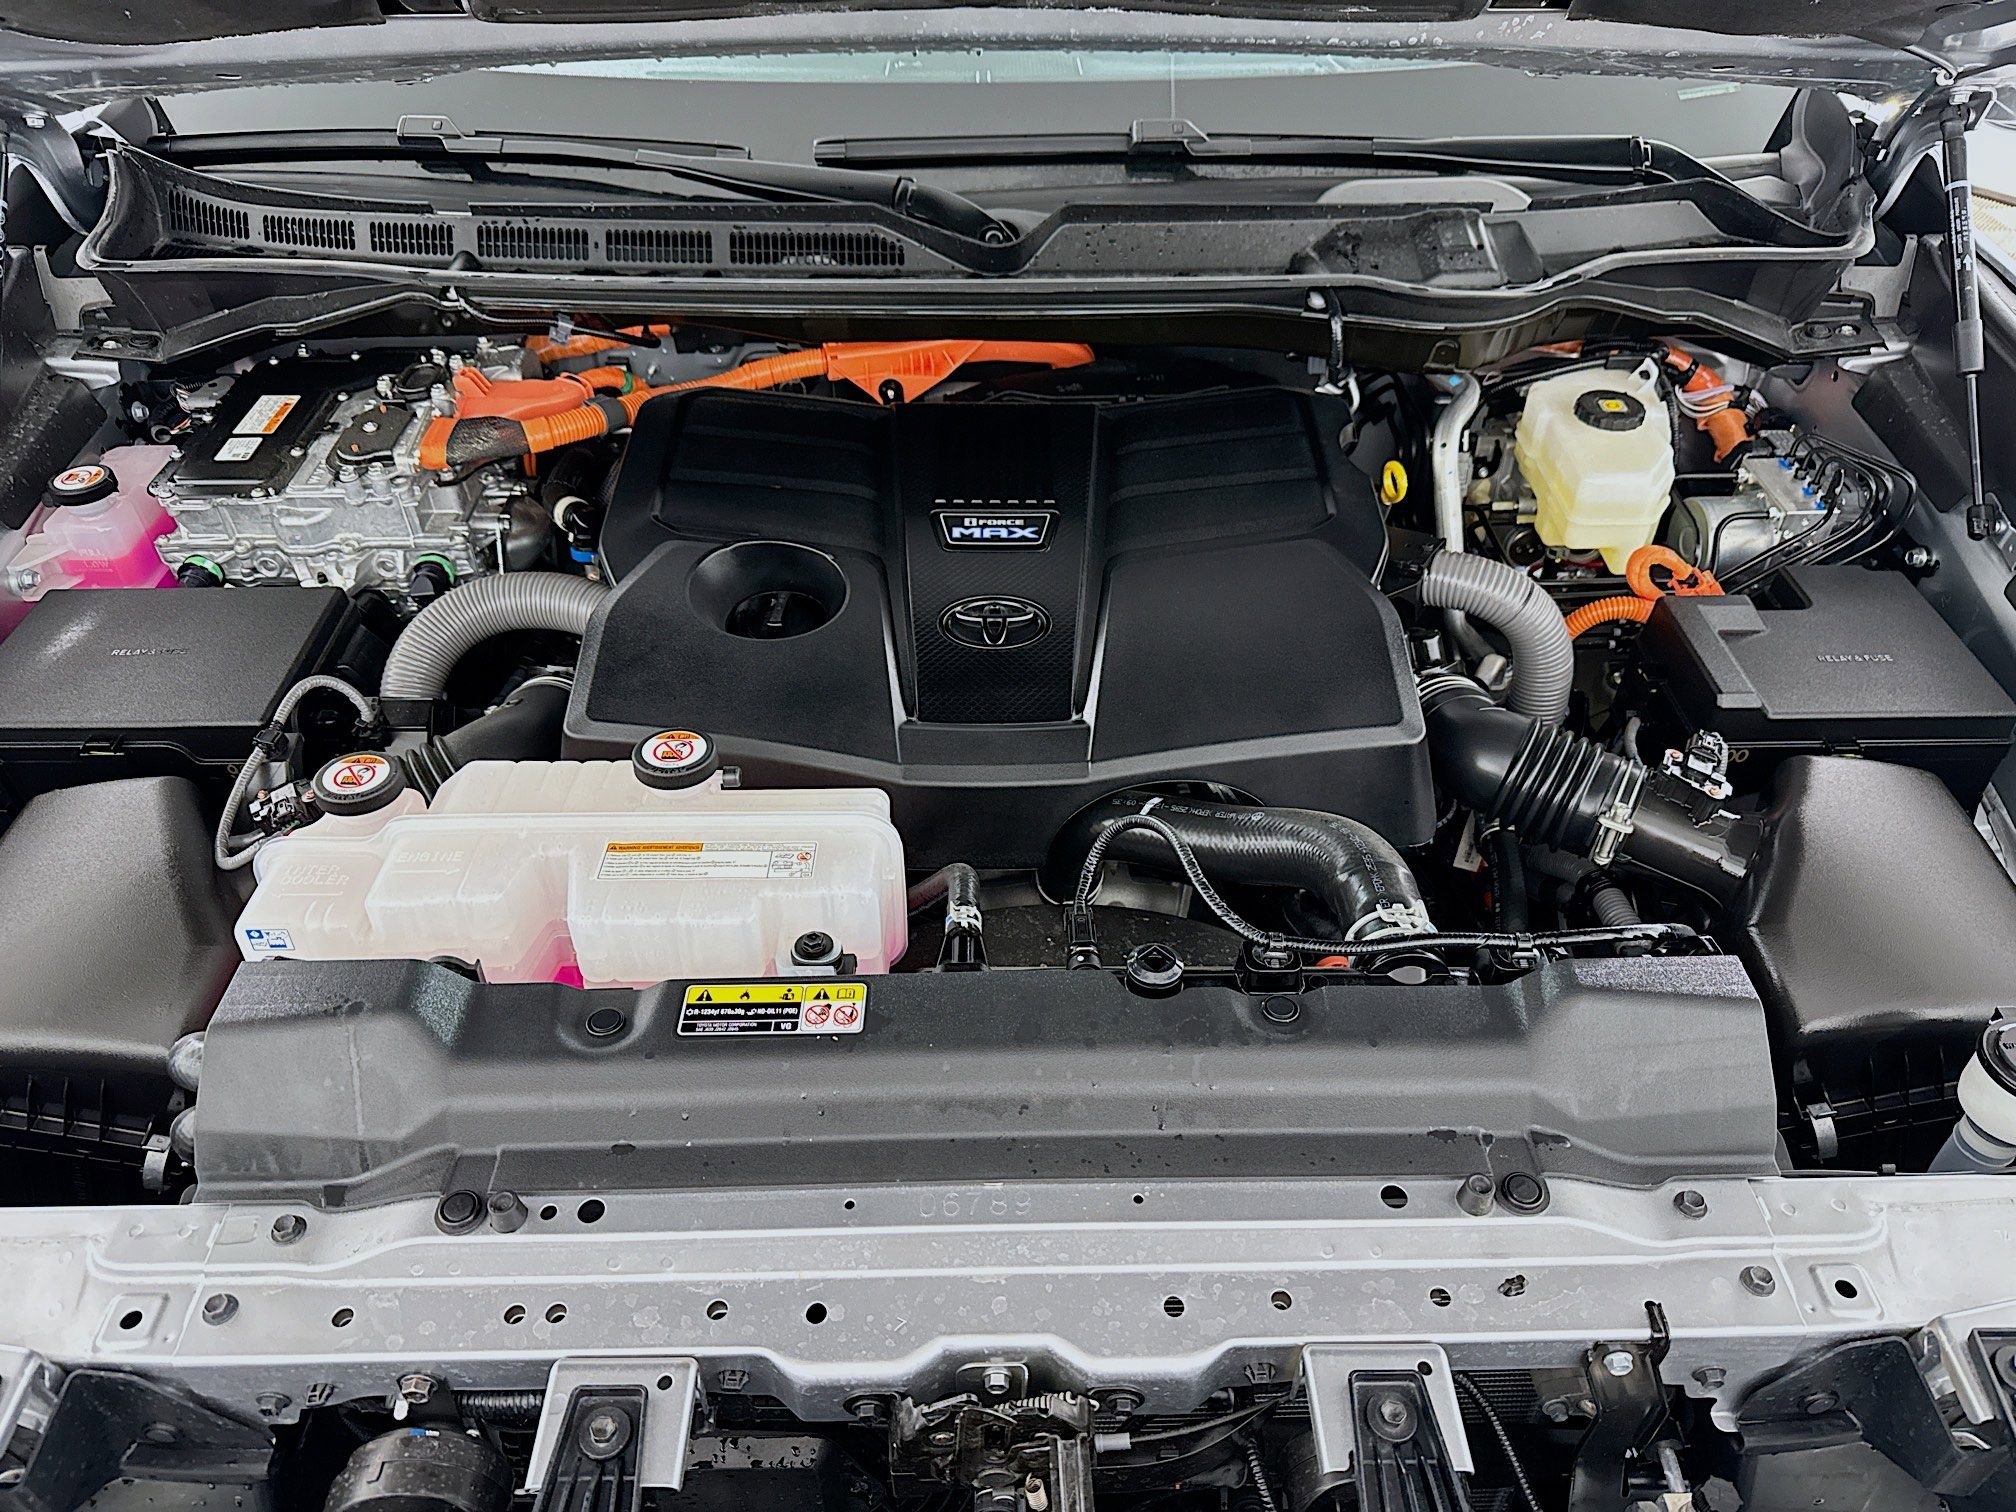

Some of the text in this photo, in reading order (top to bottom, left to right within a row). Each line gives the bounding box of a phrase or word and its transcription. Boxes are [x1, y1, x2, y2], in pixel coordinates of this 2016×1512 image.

[951, 527, 1040, 539] MAX
[111, 648, 148, 656] RELAY
[1816, 654, 1852, 662] RELAY
[1864, 654, 1893, 662] FUSE
[396, 850, 465, 863] ENGINE
[286, 864, 342, 876] INTER
[279, 874, 350, 886] COOLER
[919, 1190, 1032, 1217] 06789
